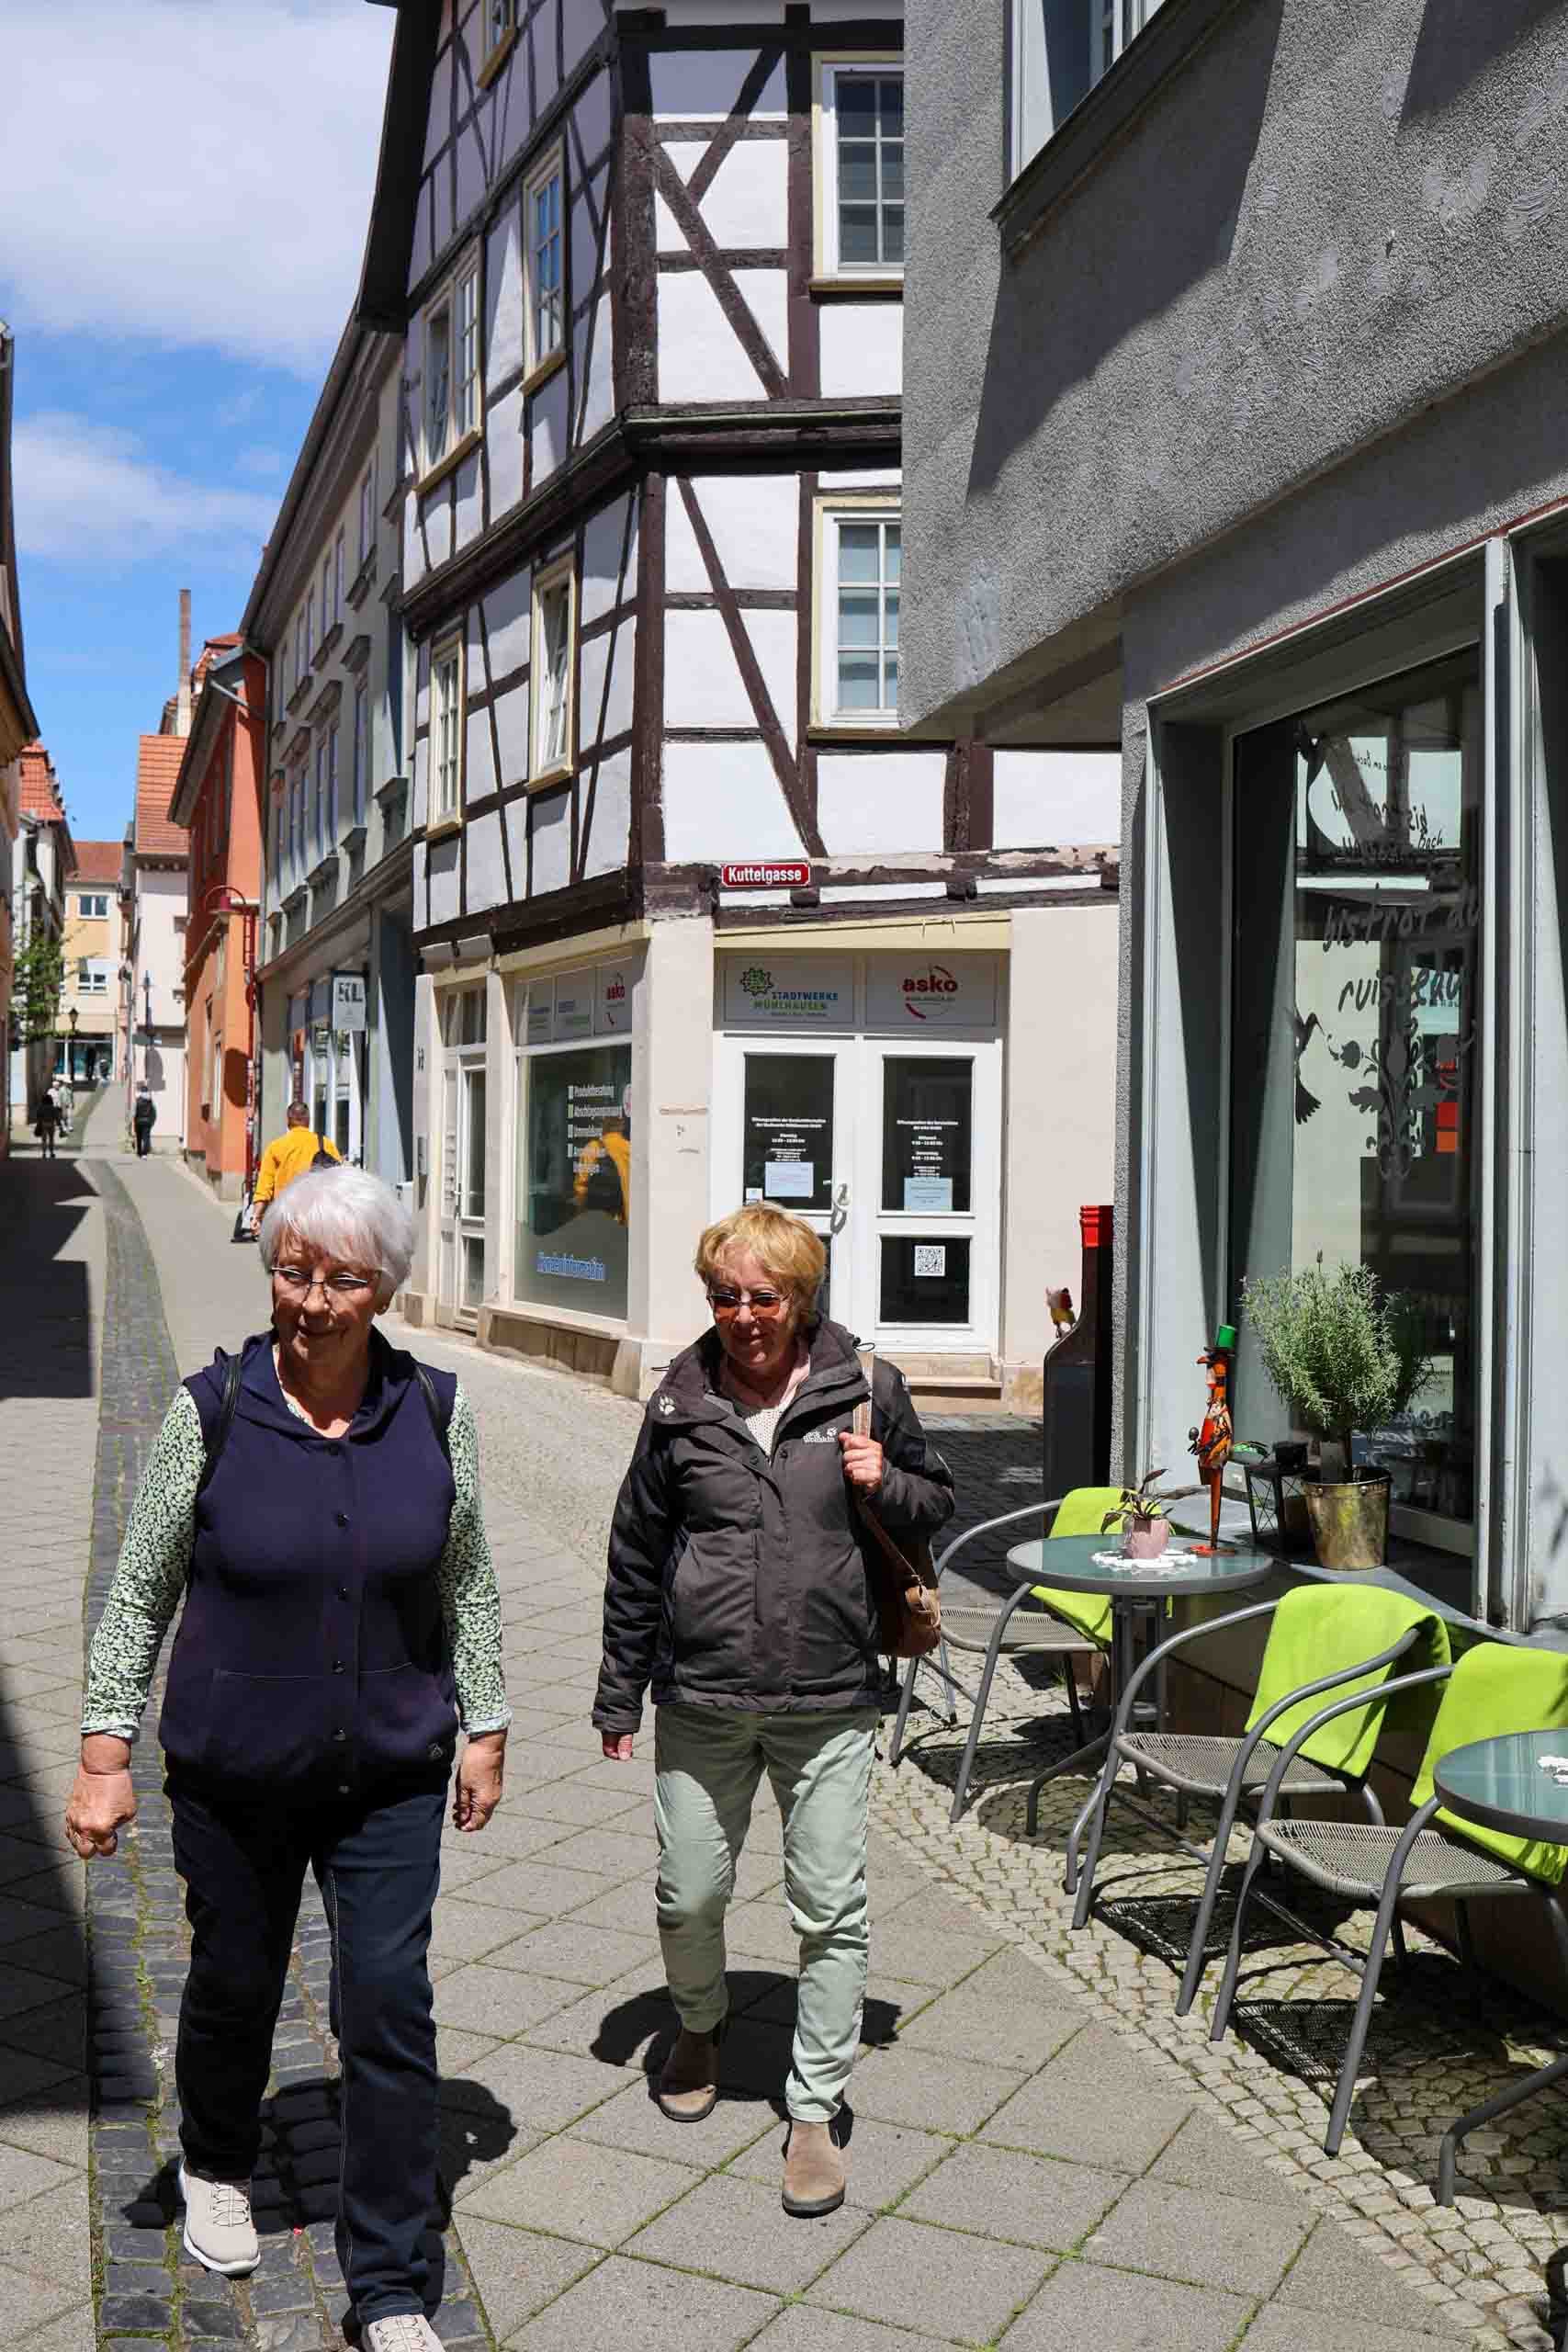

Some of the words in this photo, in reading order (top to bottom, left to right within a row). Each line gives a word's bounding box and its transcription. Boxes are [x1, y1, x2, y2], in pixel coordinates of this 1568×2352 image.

[728, 865, 802, 884] Kuttelgasse
[606, 982, 626, 1001] asko
[903, 975, 957, 992] asko
[771, 991, 839, 1001] STADTWERKE
